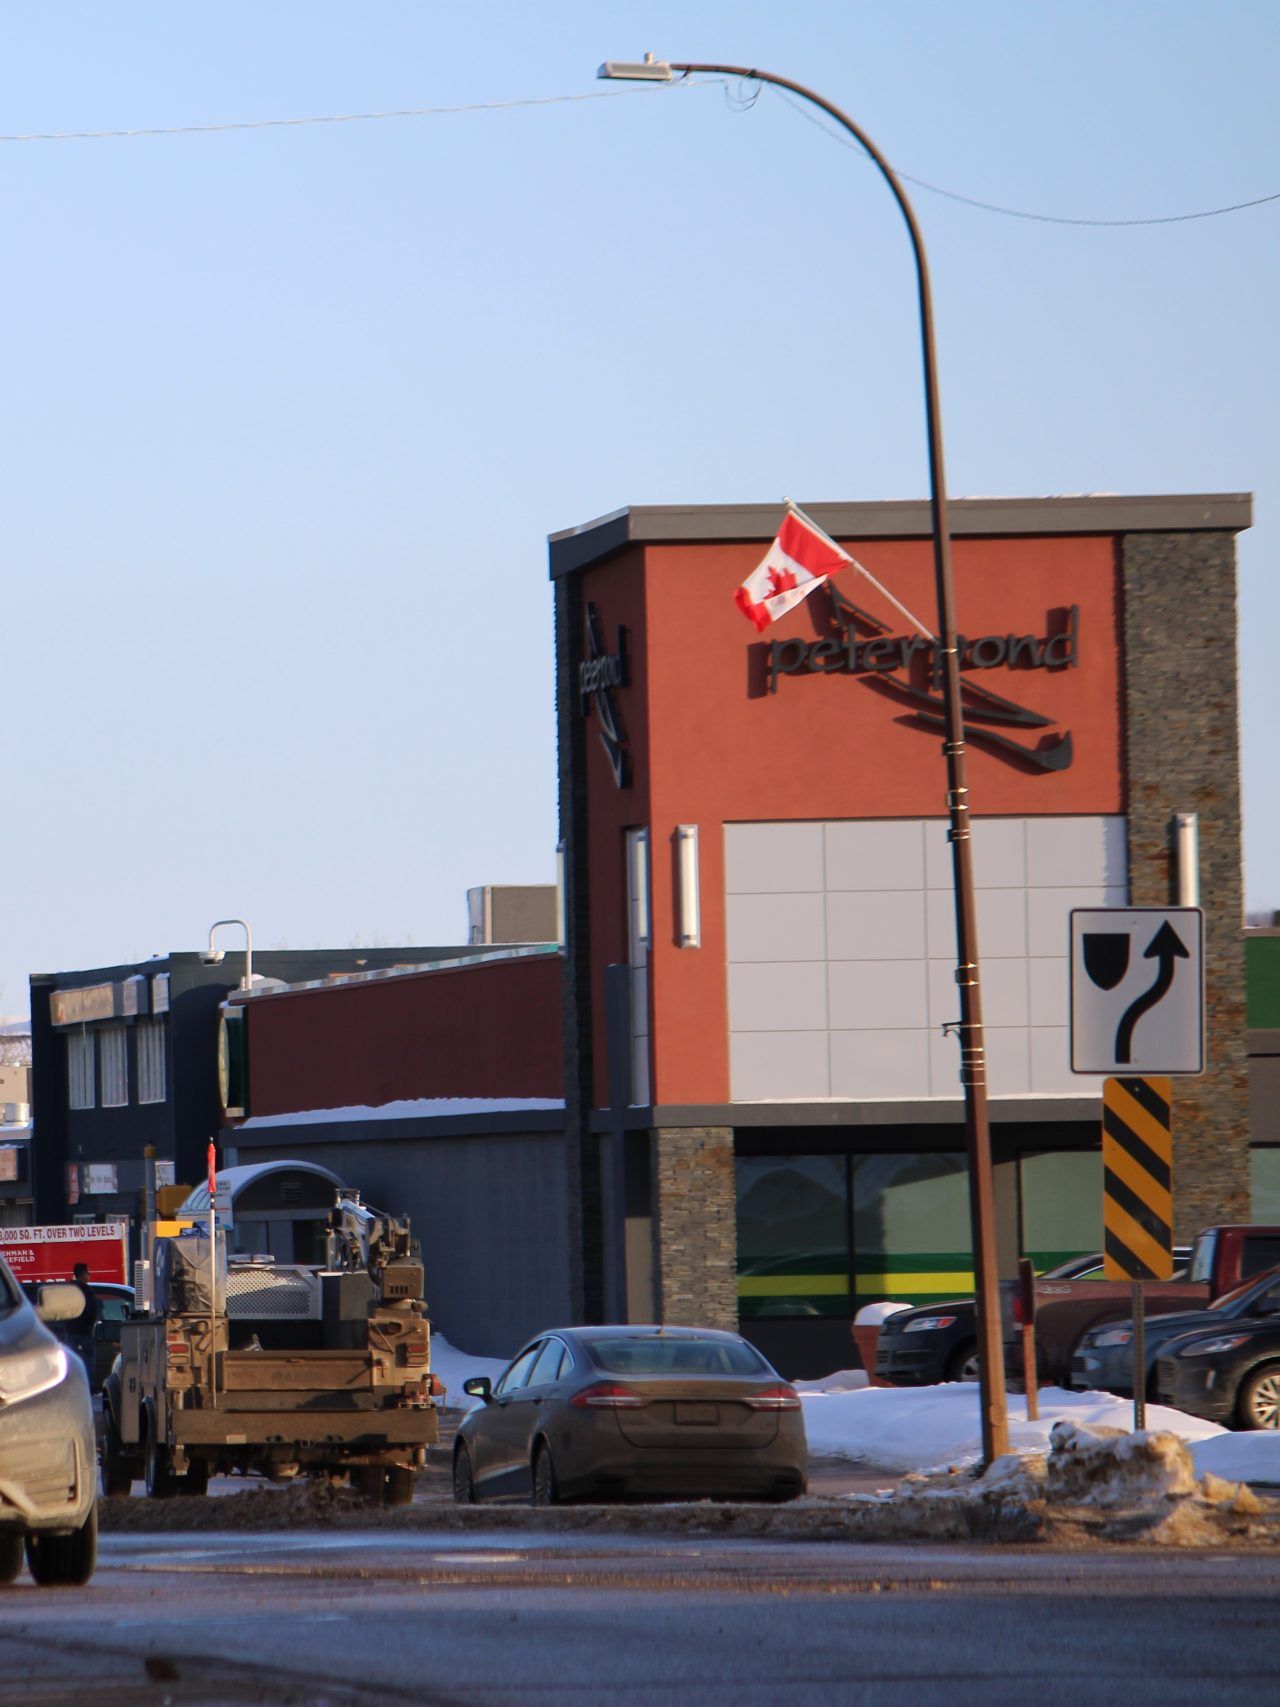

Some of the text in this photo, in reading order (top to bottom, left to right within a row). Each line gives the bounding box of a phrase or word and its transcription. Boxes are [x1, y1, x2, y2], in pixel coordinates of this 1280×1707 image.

[19, 1230, 32, 1241] SQ.
[33, 1229, 46, 1239] FT.
[47, 1228, 67, 1239] OVER
[70, 1227, 86, 1238] TWO
[87, 1225, 116, 1237] LEVELS
[2, 1249, 28, 1257] SHMAN
